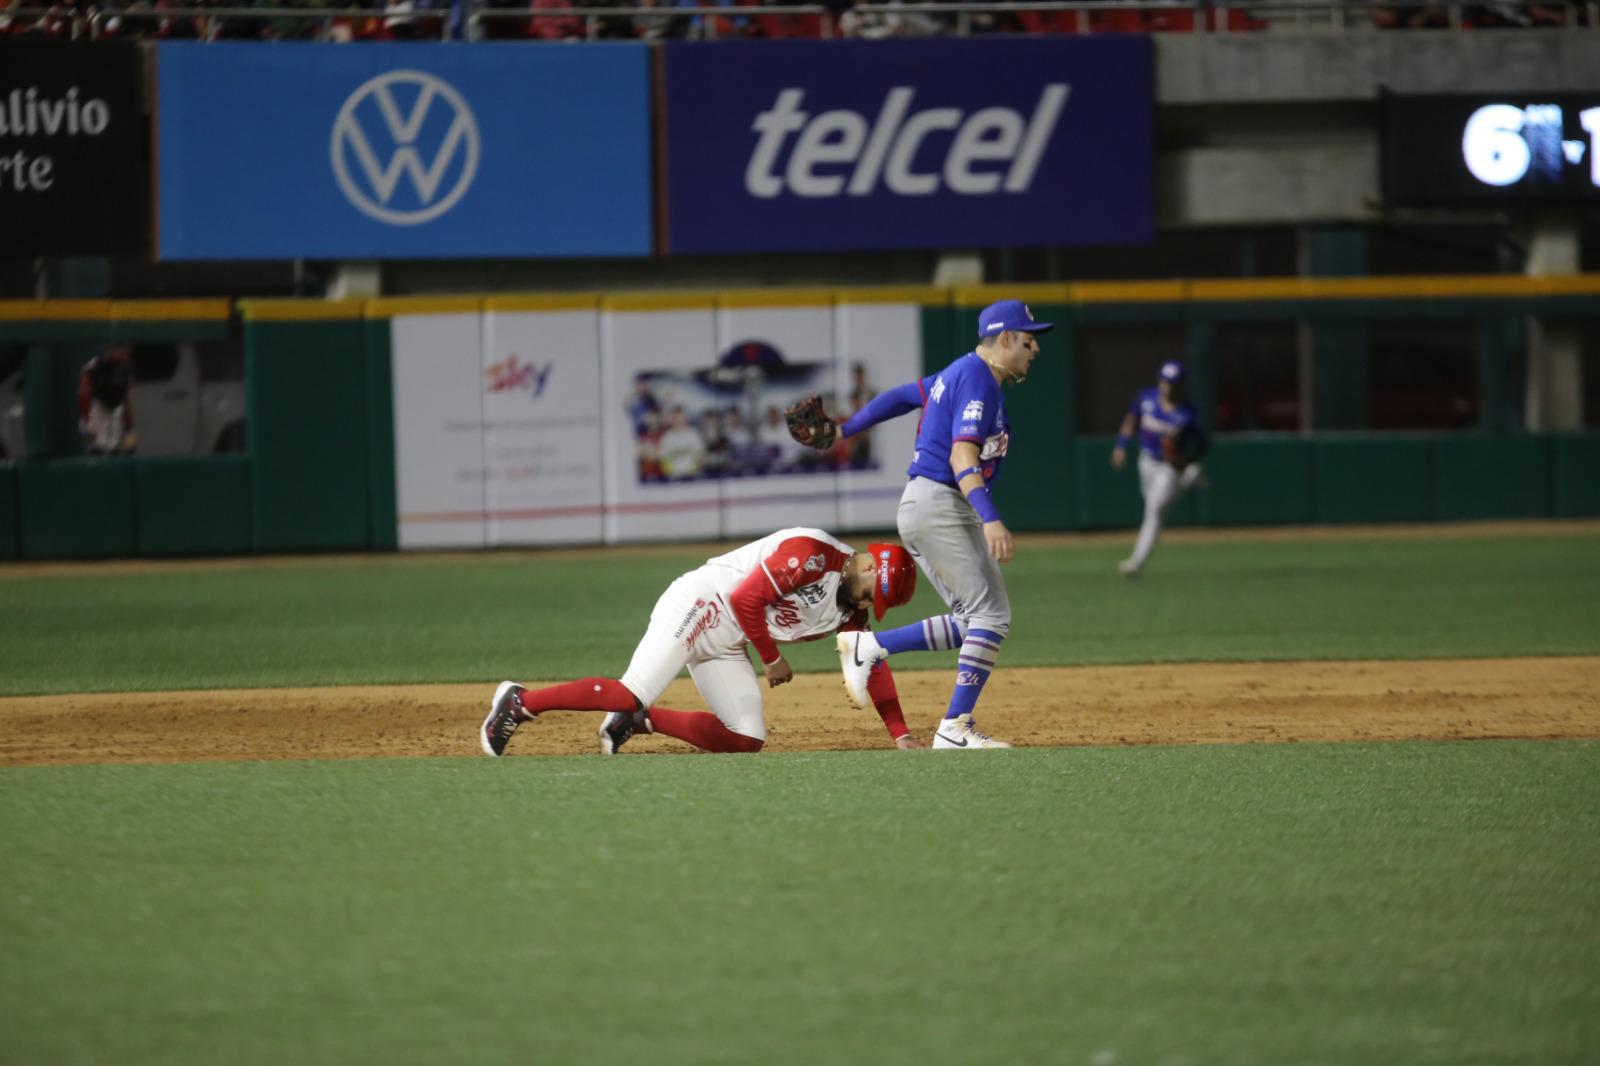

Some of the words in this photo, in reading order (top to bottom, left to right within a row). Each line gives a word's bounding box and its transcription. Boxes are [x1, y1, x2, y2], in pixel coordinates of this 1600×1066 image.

[745, 83, 1070, 197] telcel
[1463, 104, 1530, 186] 6
[483, 354, 555, 402] sky
